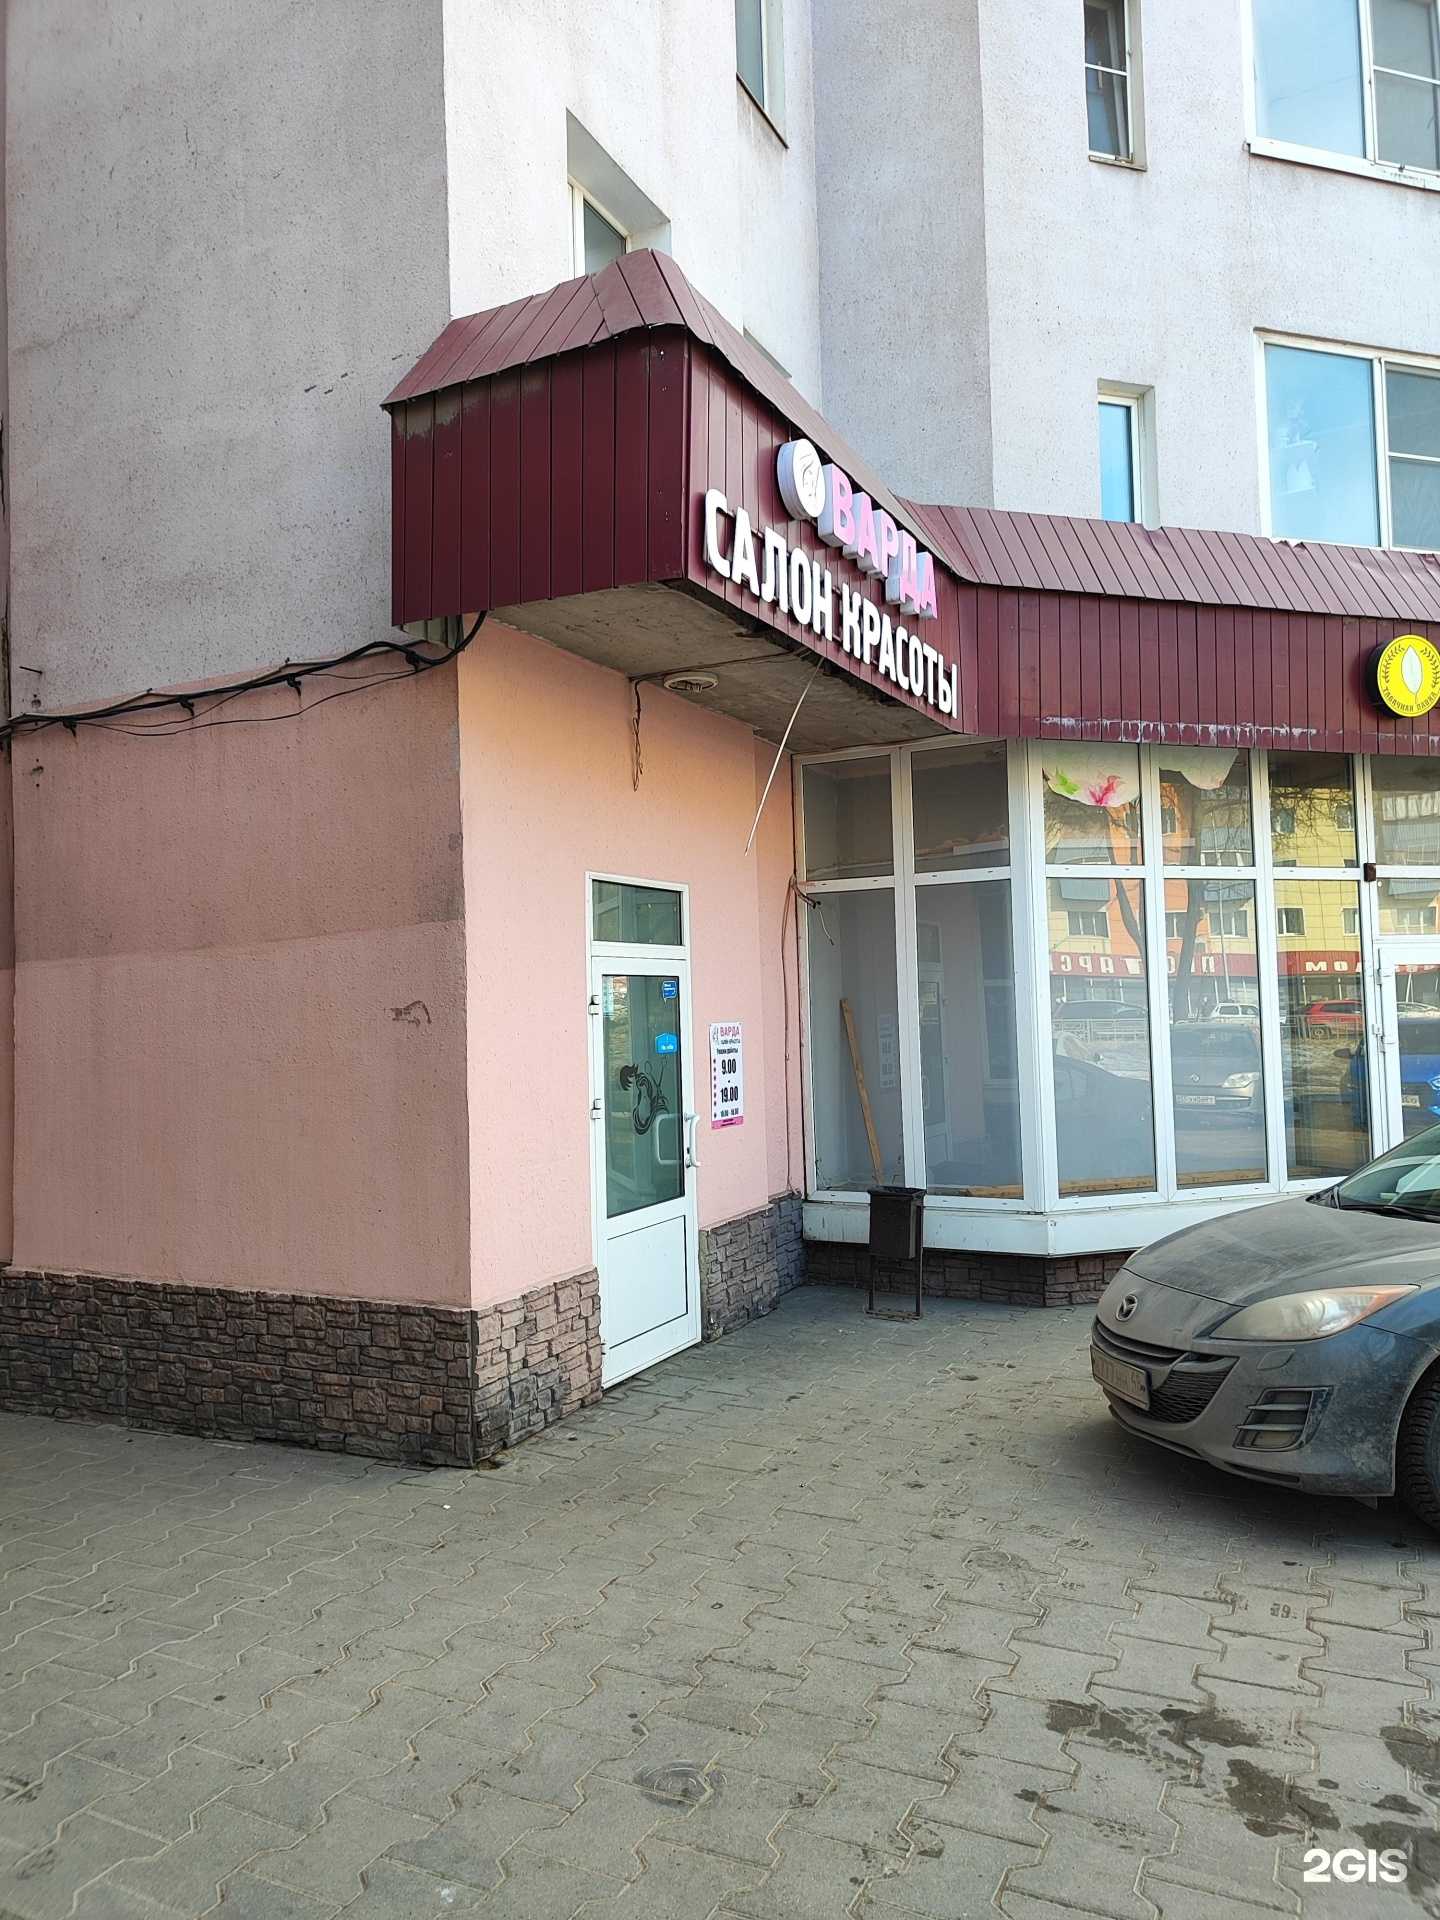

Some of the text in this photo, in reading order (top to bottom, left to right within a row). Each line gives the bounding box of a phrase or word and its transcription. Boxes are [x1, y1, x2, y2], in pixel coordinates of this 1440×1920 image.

[828, 463, 938, 619] ВАРДА
[704, 488, 958, 719] САЛОН КРАСОТЫ
[720, 1025, 740, 1038] ВАРДА
[721, 1059, 737, 1075] 9.00
[720, 1086, 739, 1103] 19.00
